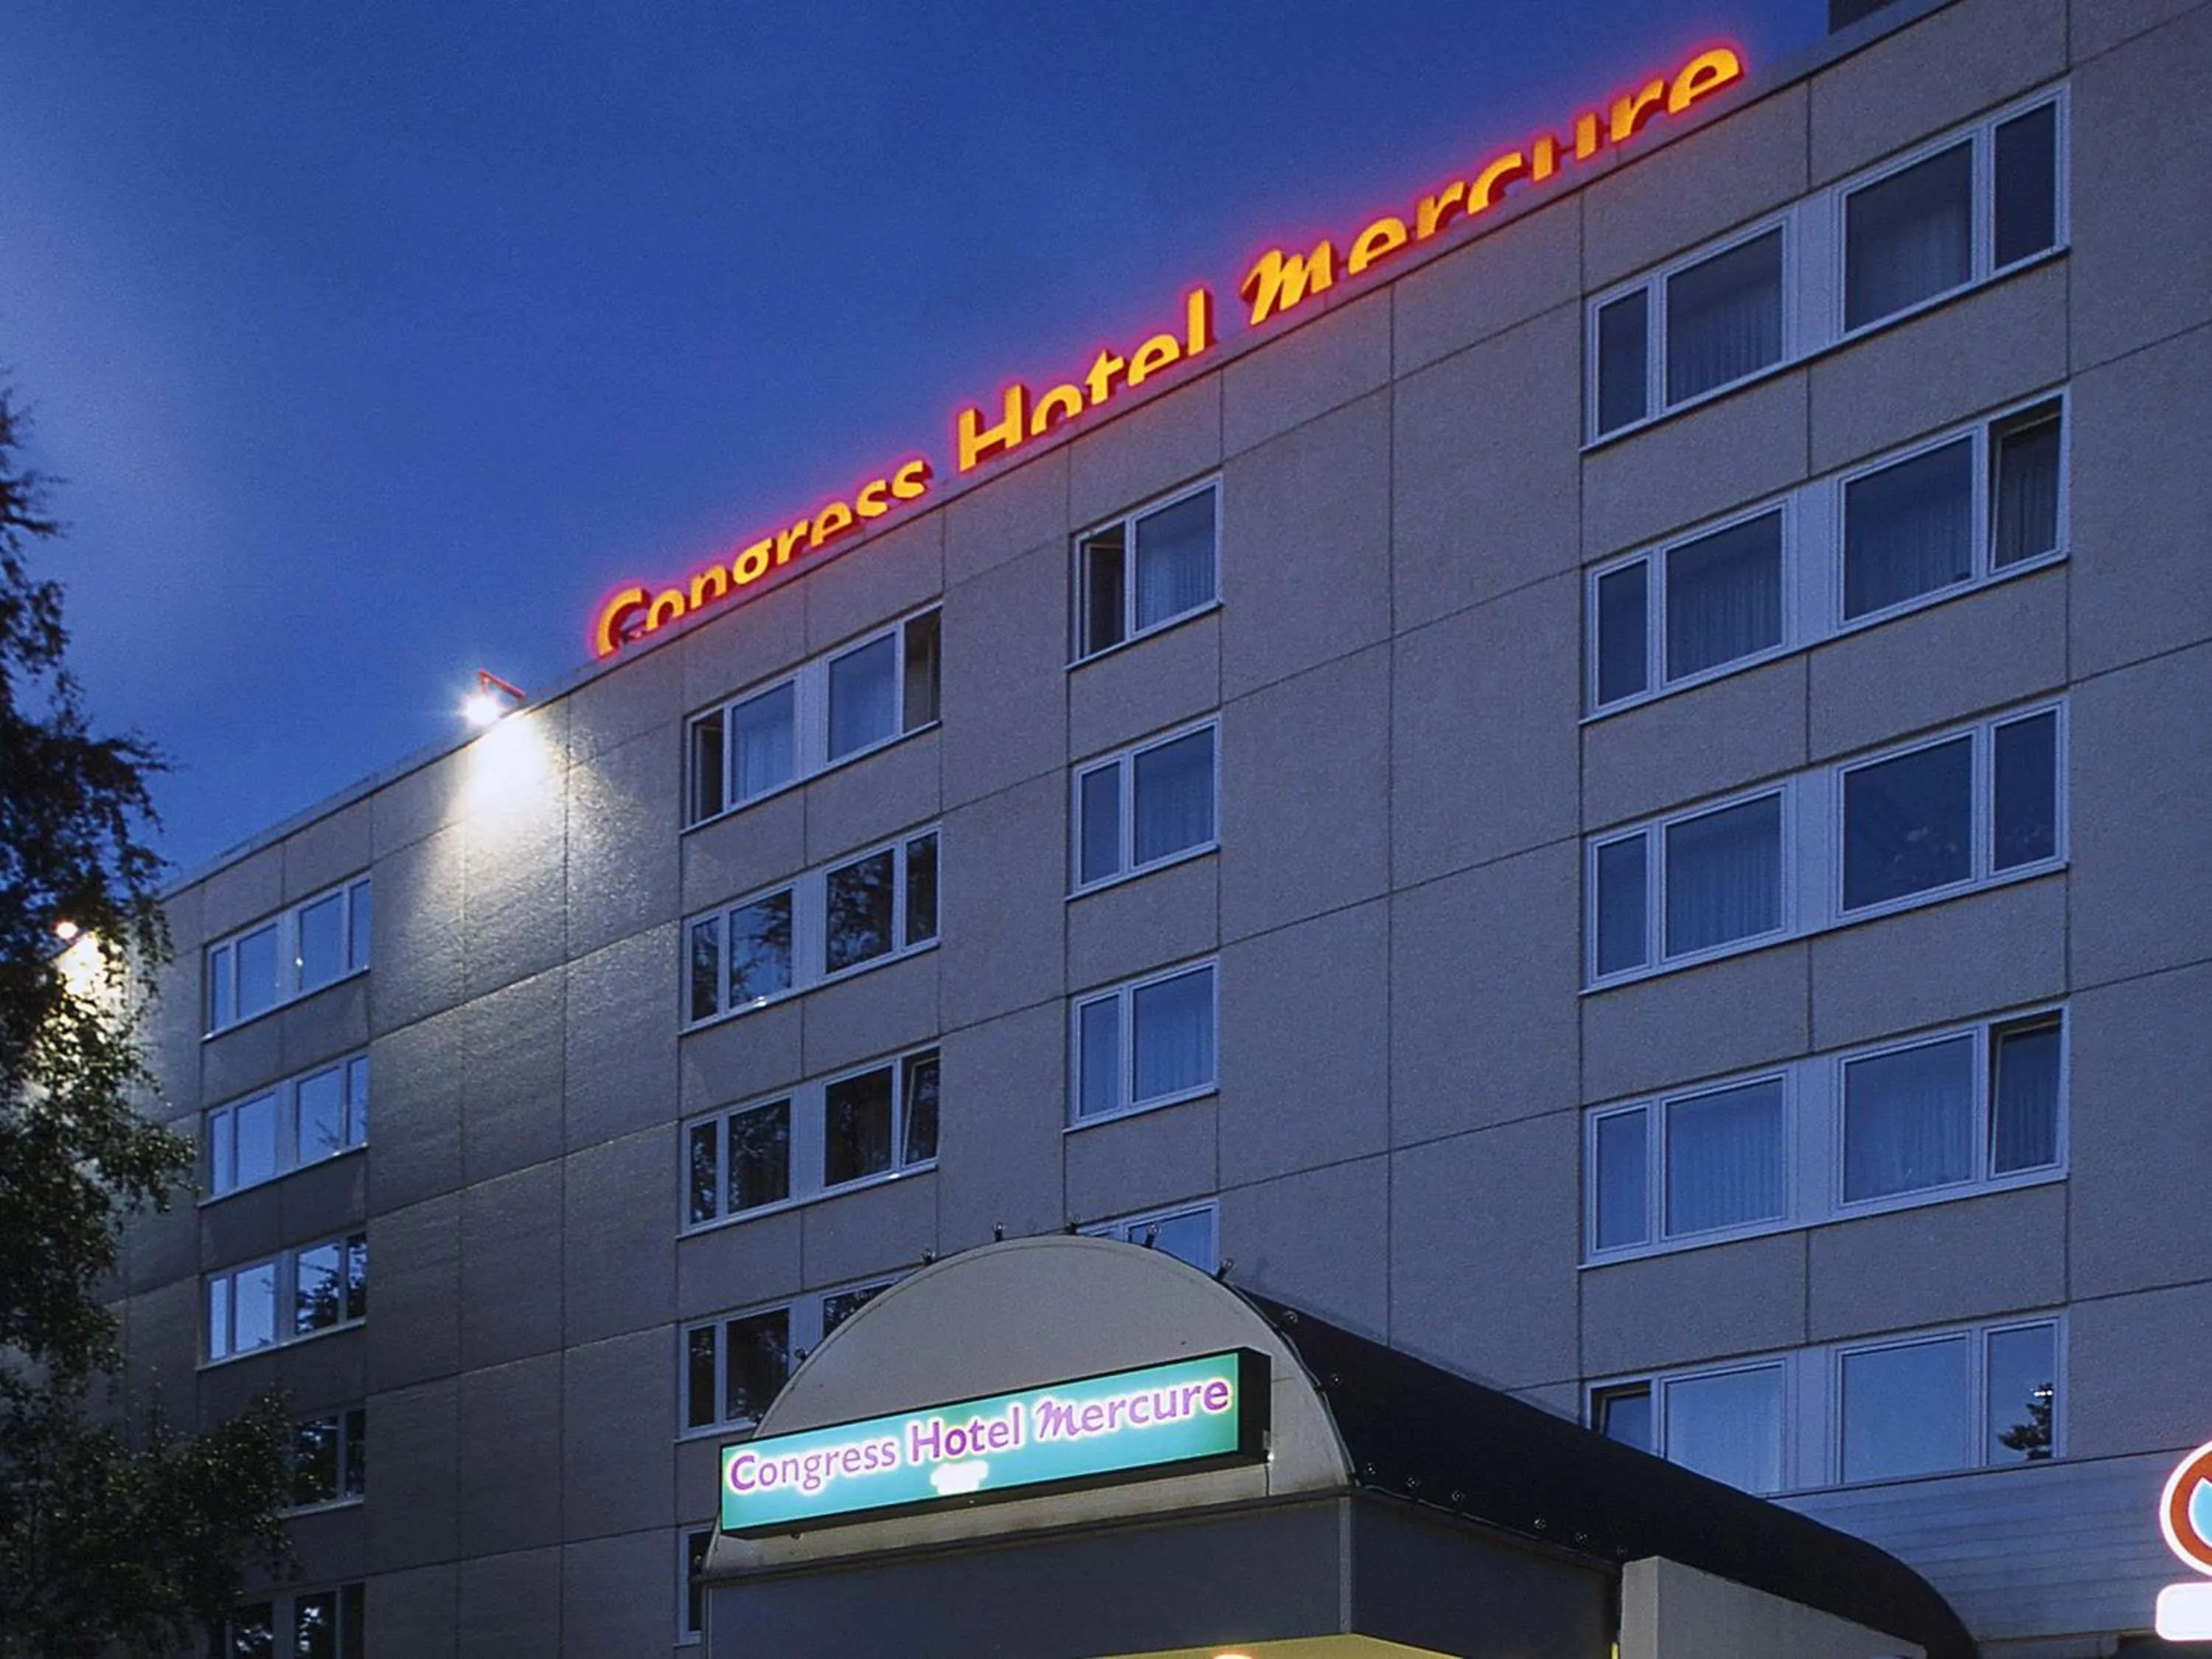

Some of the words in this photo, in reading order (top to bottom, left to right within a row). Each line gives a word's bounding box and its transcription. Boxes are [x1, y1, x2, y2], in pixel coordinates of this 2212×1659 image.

[728, 1439, 896, 1492] Congress
[910, 1407, 1021, 1463] Hotel
[1037, 1380, 1229, 1439] Mercure
